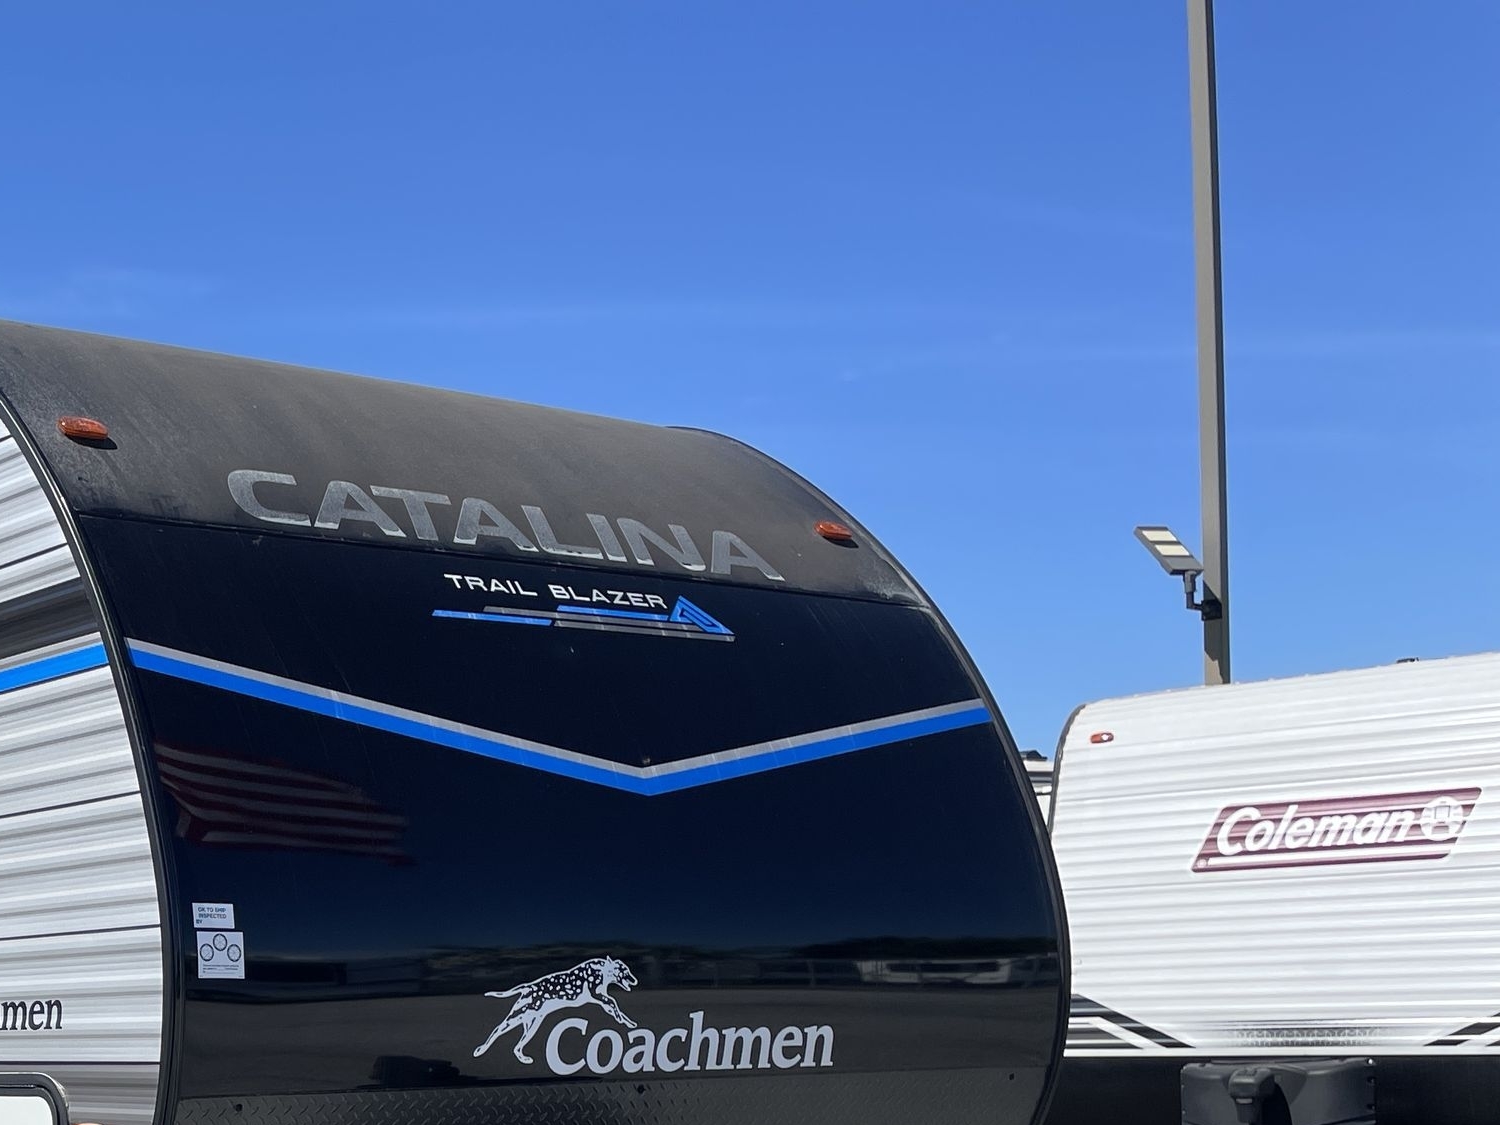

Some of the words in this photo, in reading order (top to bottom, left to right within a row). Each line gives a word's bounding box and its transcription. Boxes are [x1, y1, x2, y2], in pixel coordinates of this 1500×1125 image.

[227, 469, 785, 582] CATALINA
[443, 573, 538, 597] TRAIL
[547, 584, 668, 610] BLAZER
[1216, 804, 1416, 857] Coleman
[545, 1011, 835, 1076] Coachmen
